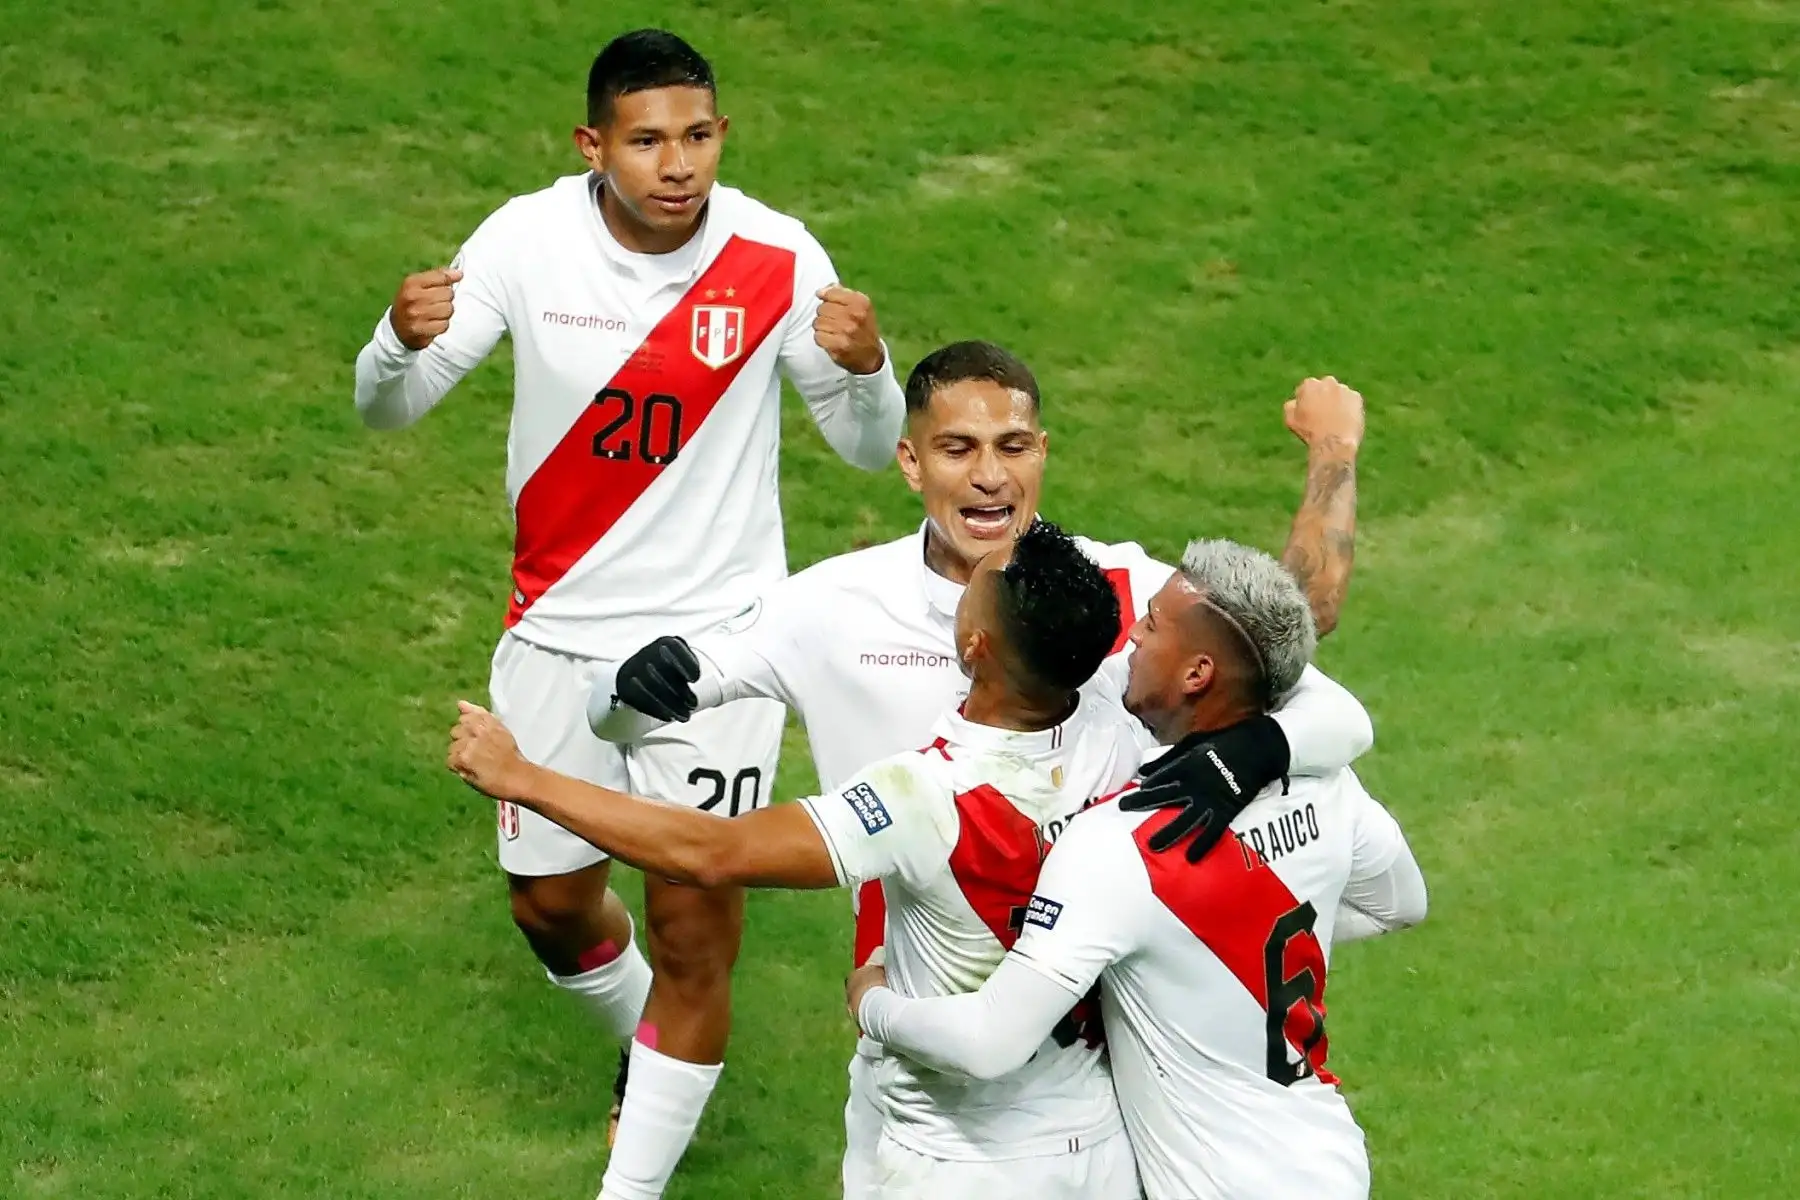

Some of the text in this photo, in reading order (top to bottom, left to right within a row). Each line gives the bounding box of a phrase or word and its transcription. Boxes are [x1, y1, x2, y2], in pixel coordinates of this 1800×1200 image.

[542, 310, 627, 333] marathon
[592, 387, 683, 465] 20
[859, 651, 949, 668] marathon
[687, 766, 762, 817] 20
[1206, 749, 1242, 795] marathon
[844, 790, 877, 829] grande
[856, 784, 888, 826] Cree en
[1233, 802, 1320, 871] TRAUCO
[1044, 903, 1060, 916] en
[1263, 900, 1324, 1087] 6
